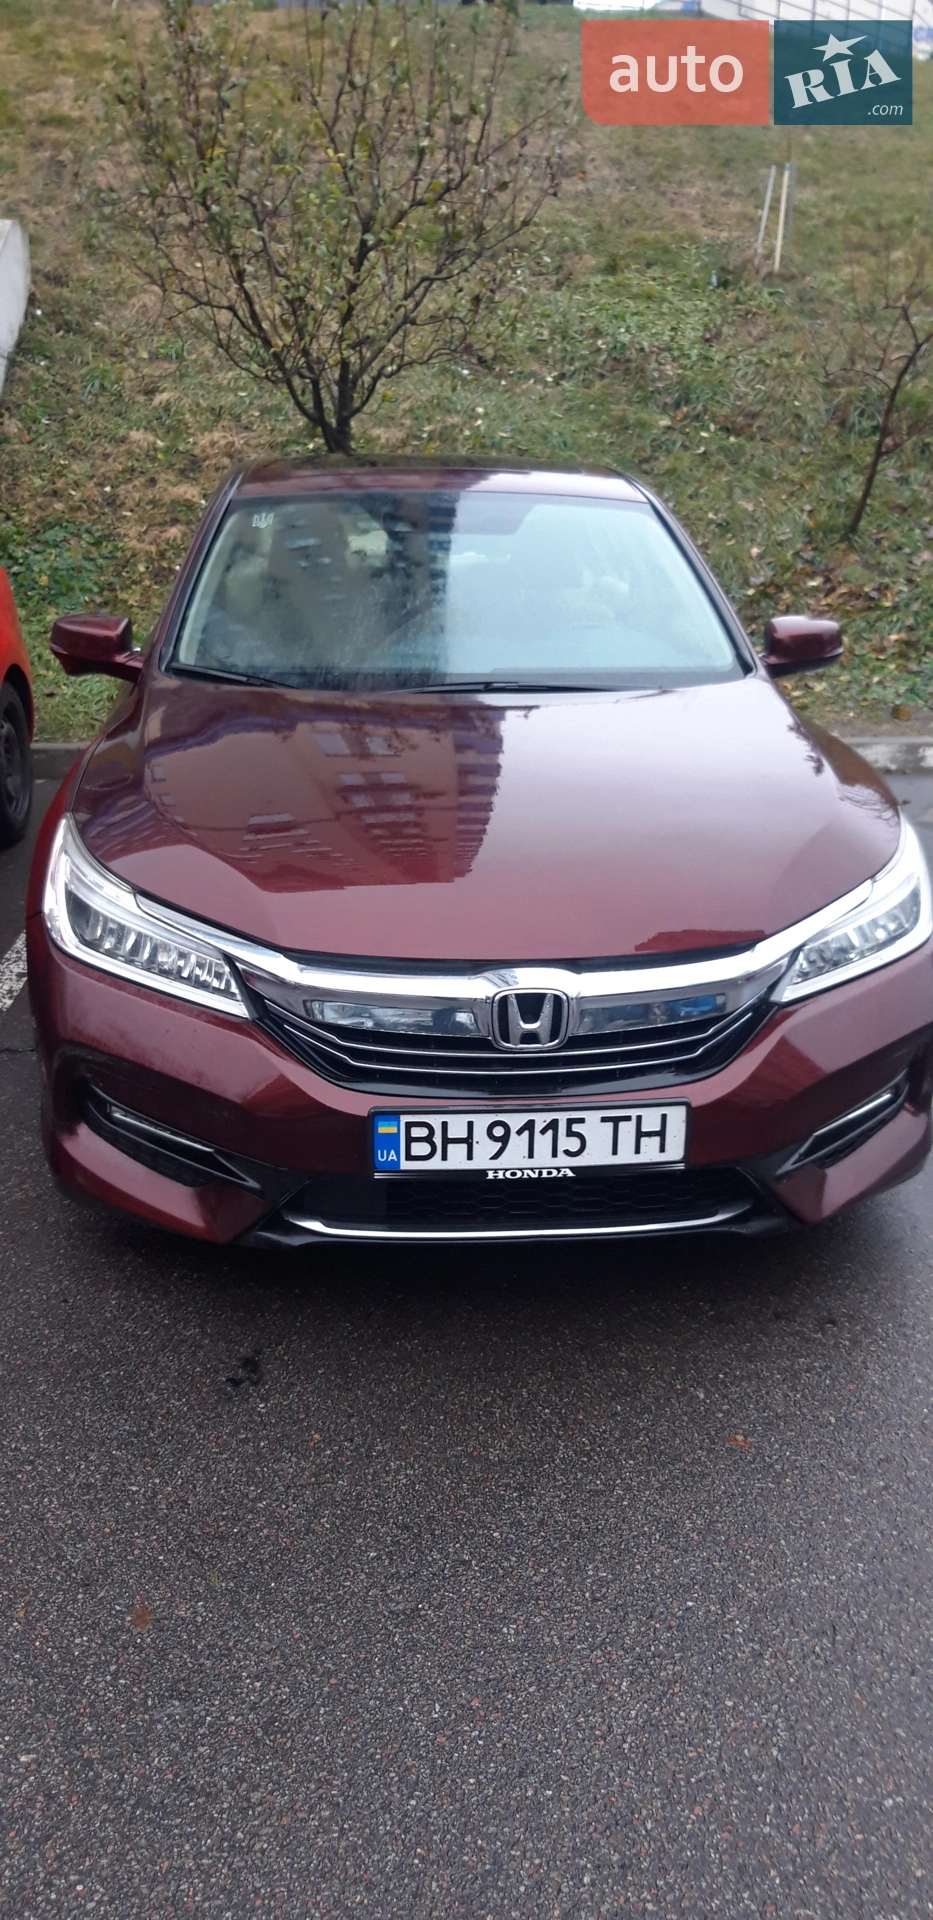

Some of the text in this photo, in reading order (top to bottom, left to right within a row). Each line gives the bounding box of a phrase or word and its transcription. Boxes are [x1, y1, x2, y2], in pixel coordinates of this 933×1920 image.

[404, 1112, 668, 1162] BH 9115 TH
[377, 1149, 398, 1162] UA
[485, 1167, 576, 1180] HONDA
